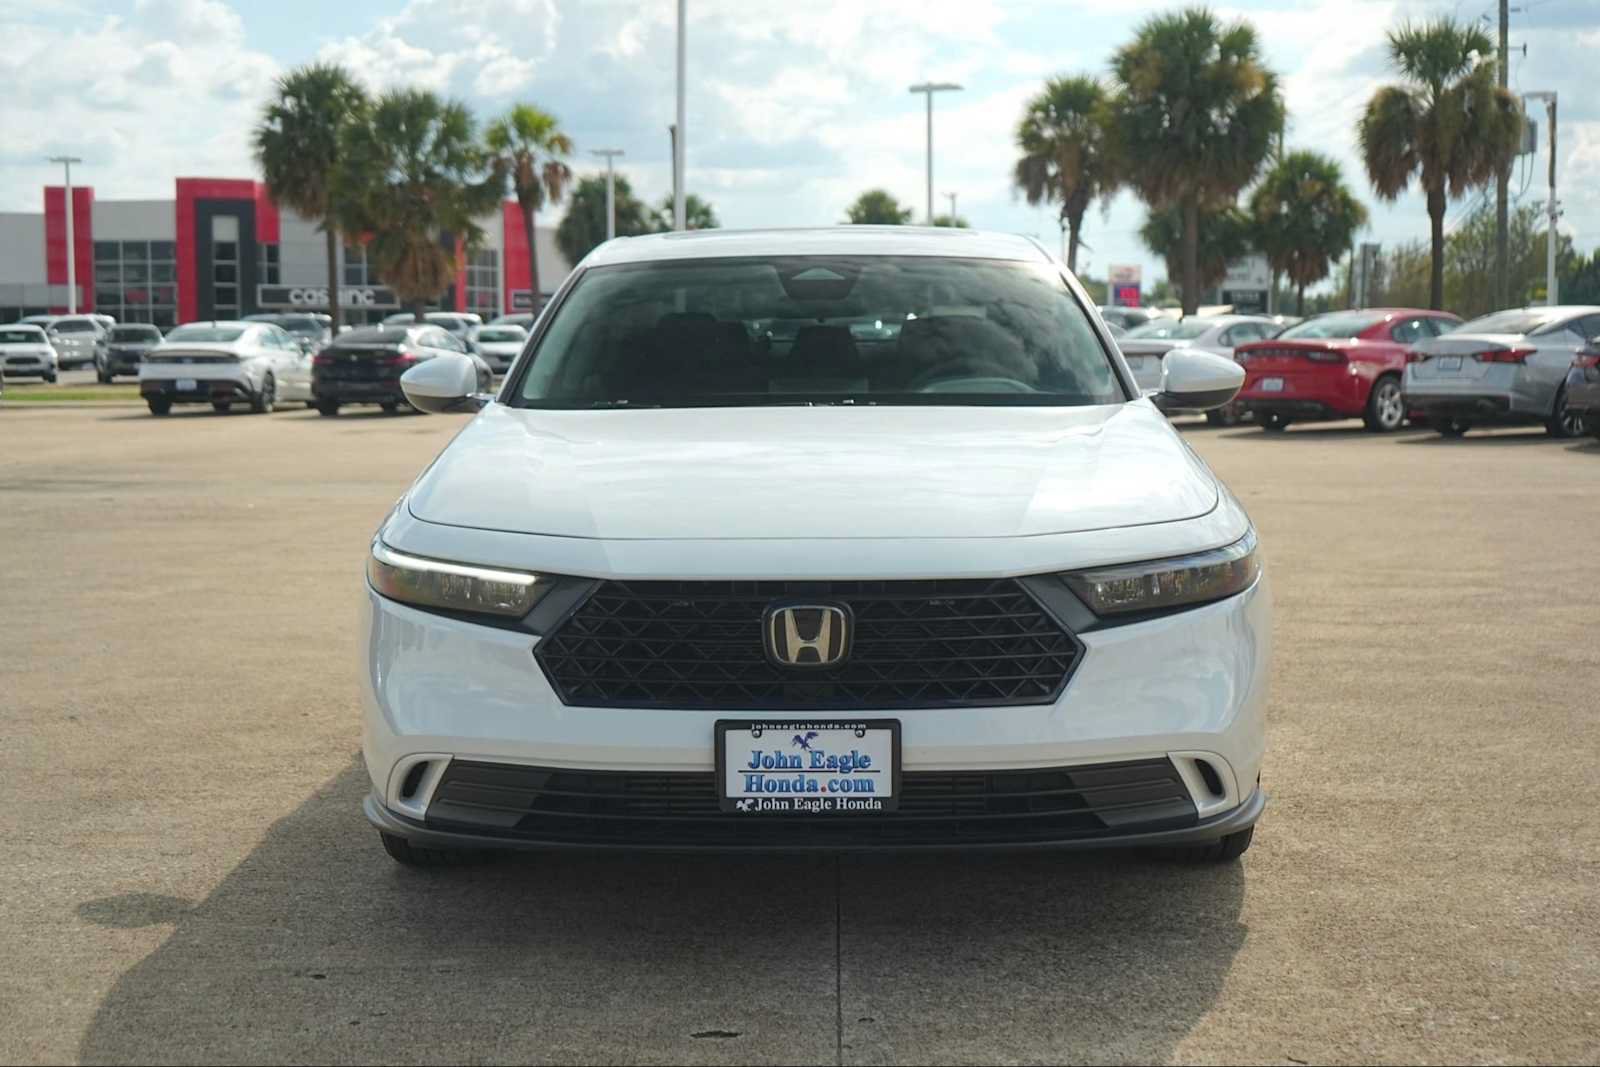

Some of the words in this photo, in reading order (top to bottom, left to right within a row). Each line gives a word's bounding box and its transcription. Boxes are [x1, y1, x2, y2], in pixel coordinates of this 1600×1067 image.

[748, 750, 803, 769] John
[808, 750, 872, 774] Eagle
[743, 774, 875, 793] Honda.com
[755, 798, 790, 810] John
[794, 798, 833, 812] Eagle
[835, 798, 882, 810] Honda
